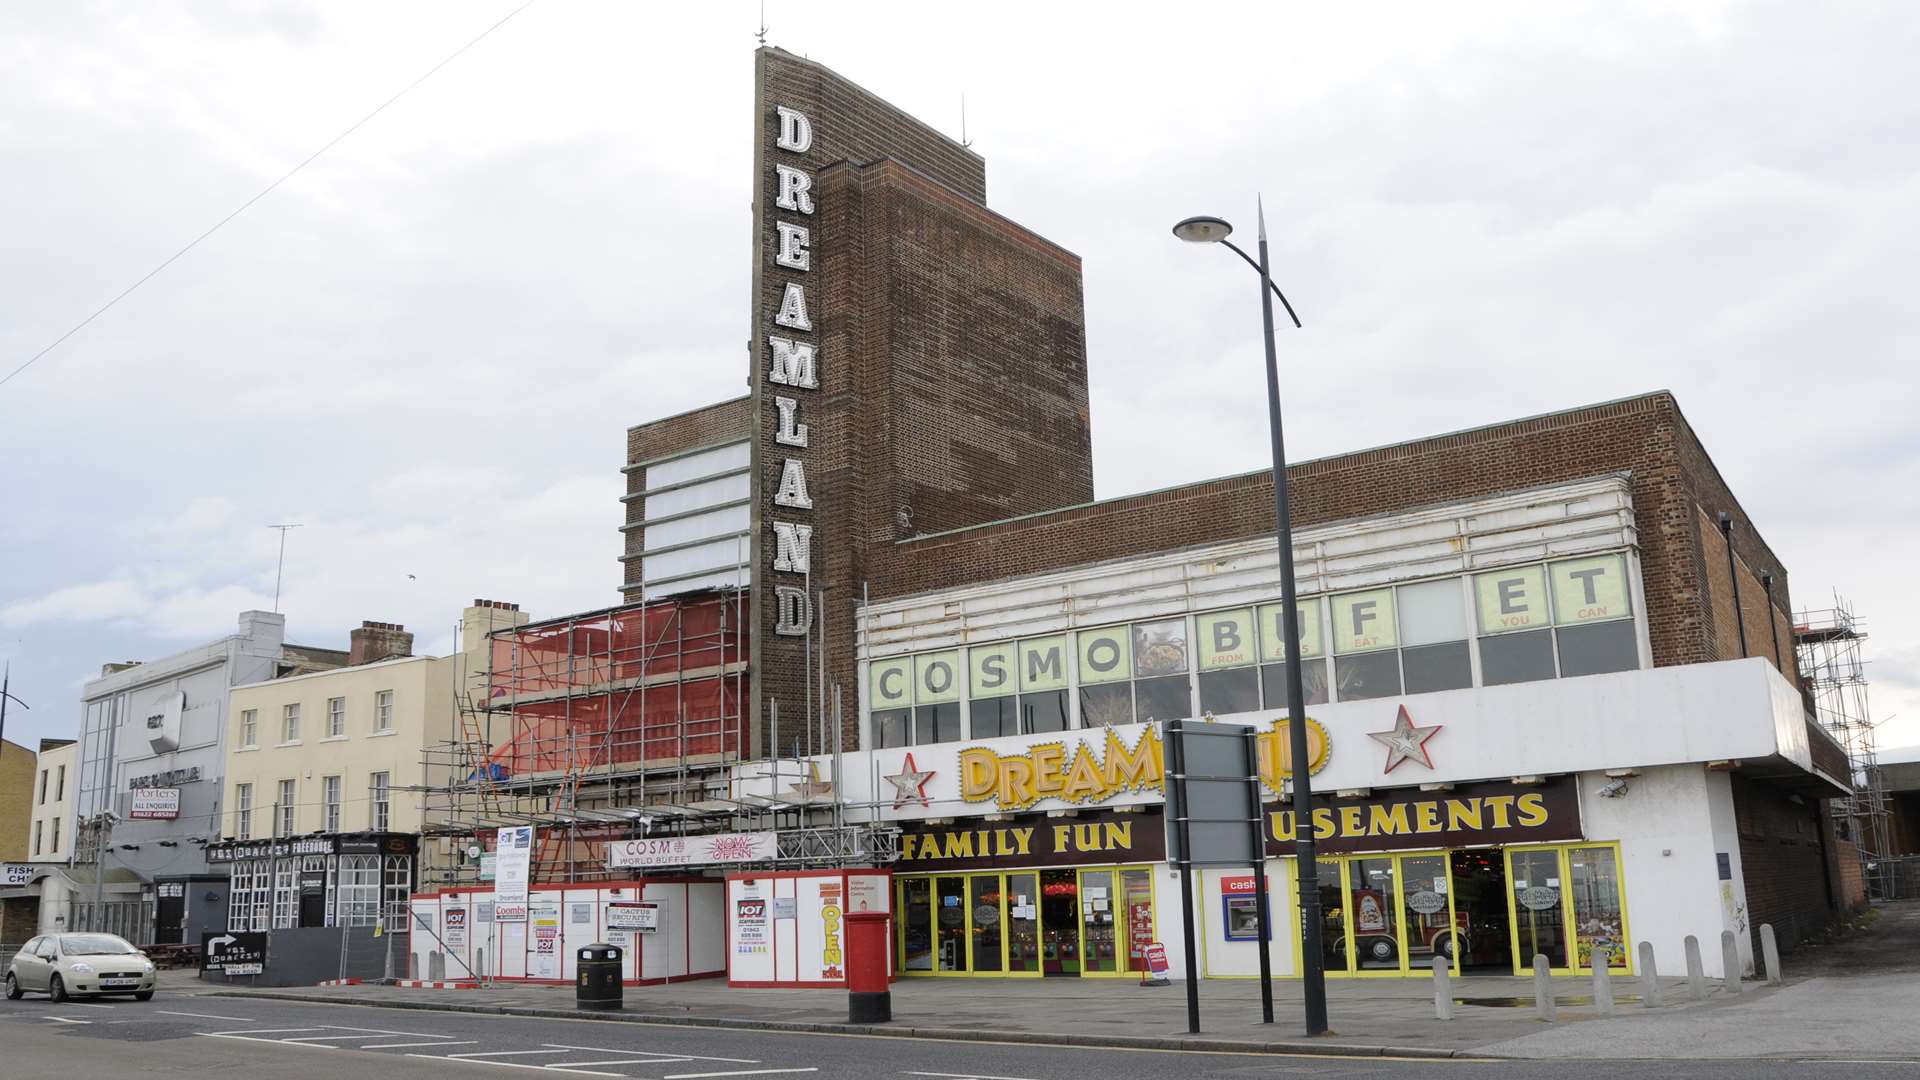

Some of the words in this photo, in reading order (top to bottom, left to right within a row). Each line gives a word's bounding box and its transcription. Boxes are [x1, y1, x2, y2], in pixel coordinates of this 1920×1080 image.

[768, 105, 819, 637] DREAMLAND
[1211, 653, 1244, 665] FROM
[1354, 636, 1379, 649] EAT
[1500, 614, 1530, 627] YOU
[1577, 605, 1608, 620] CAN
[878, 637, 1121, 700] COSMO
[902, 827, 1035, 861] FAMILY
[1052, 820, 1133, 853] FUN
[1263, 793, 1549, 843] USEMENTS
[619, 856, 654, 865] WORLD
[656, 855, 691, 864] BUFFET
[712, 847, 752, 860] OPEN
[714, 836, 748, 850] NOW
[7, 866, 34, 874] FISH
[1230, 879, 1256, 890] cash
[821, 905, 842, 966] OPEN
